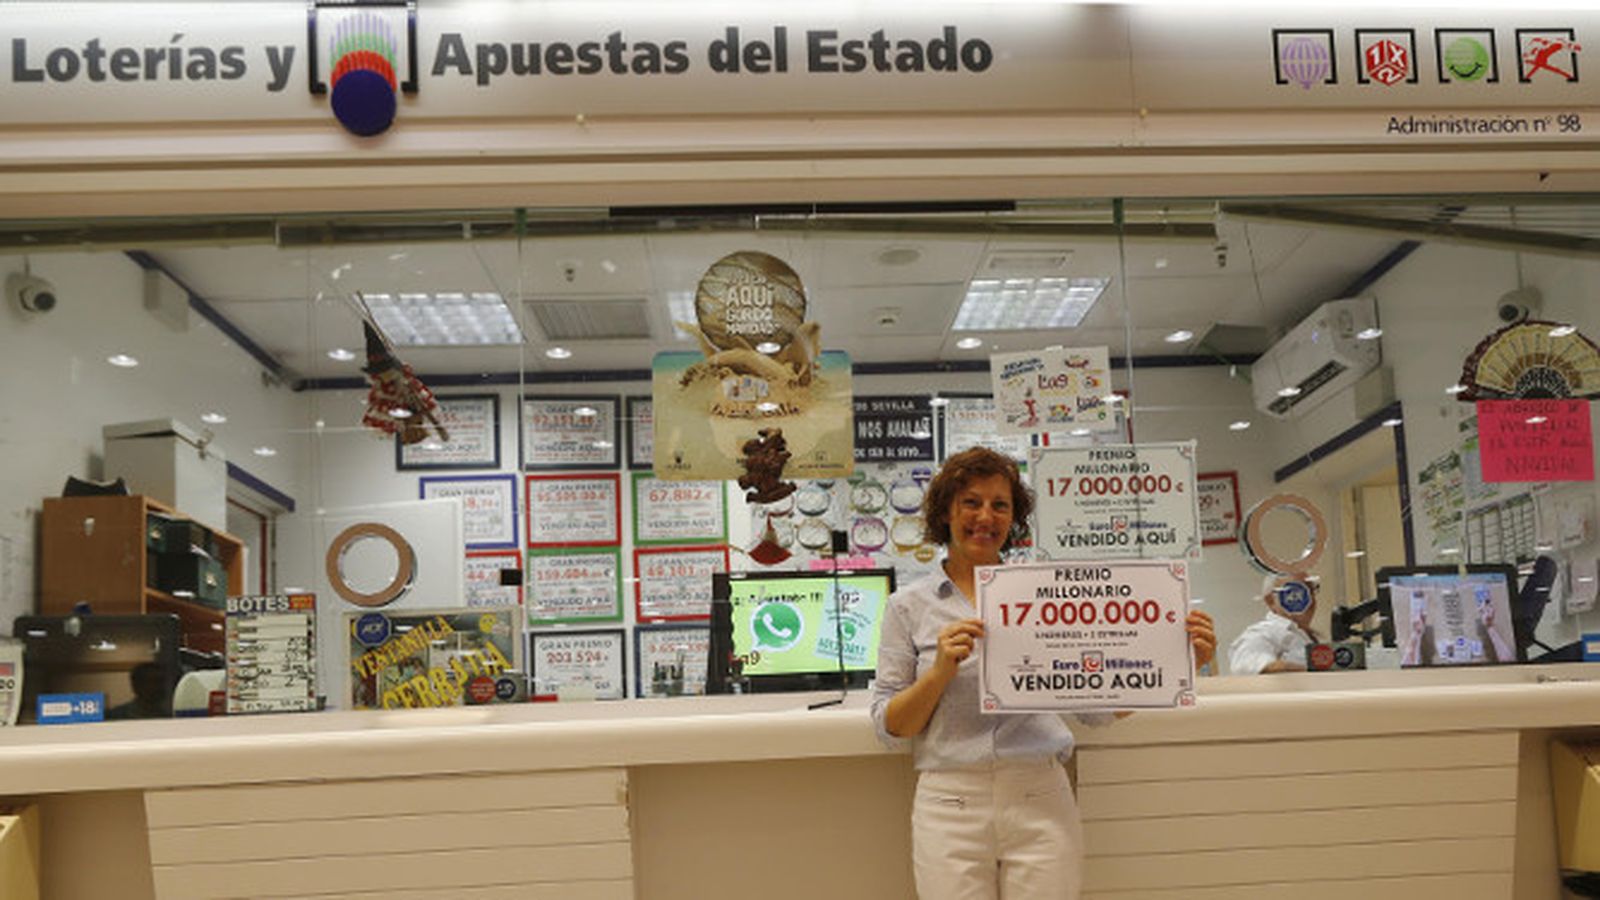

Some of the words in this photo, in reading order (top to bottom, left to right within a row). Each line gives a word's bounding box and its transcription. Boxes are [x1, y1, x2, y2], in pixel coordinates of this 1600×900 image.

[12, 34, 247, 83] Loterías
[267, 45, 294, 92] y
[432, 34, 690, 86] Apuestas
[708, 27, 788, 74] del
[806, 26, 993, 73] Estado
[1387, 113, 1528, 135] Administración
[1556, 114, 1582, 132] 98
[858, 421, 884, 438] NOS
[1088, 449, 1136, 460] PREMIO
[1074, 462, 1150, 475] MILLONARIO
[1047, 475, 1172, 497] 17.000.000
[1057, 531, 1129, 547] VENDIDO
[1134, 528, 1176, 545] AQUÍ
[1055, 567, 1112, 581] PREMIO
[1036, 584, 1132, 599] MILLONARIO
[226, 596, 290, 613] BOTES
[1000, 600, 1160, 626] 17.000.000
[540, 640, 572, 651] GRAN
[573, 640, 613, 650] PREMIO
[1052, 659, 1080, 671] Euro
[1011, 673, 1104, 691] VENDIDO
[1110, 667, 1163, 689] AQUÍ
